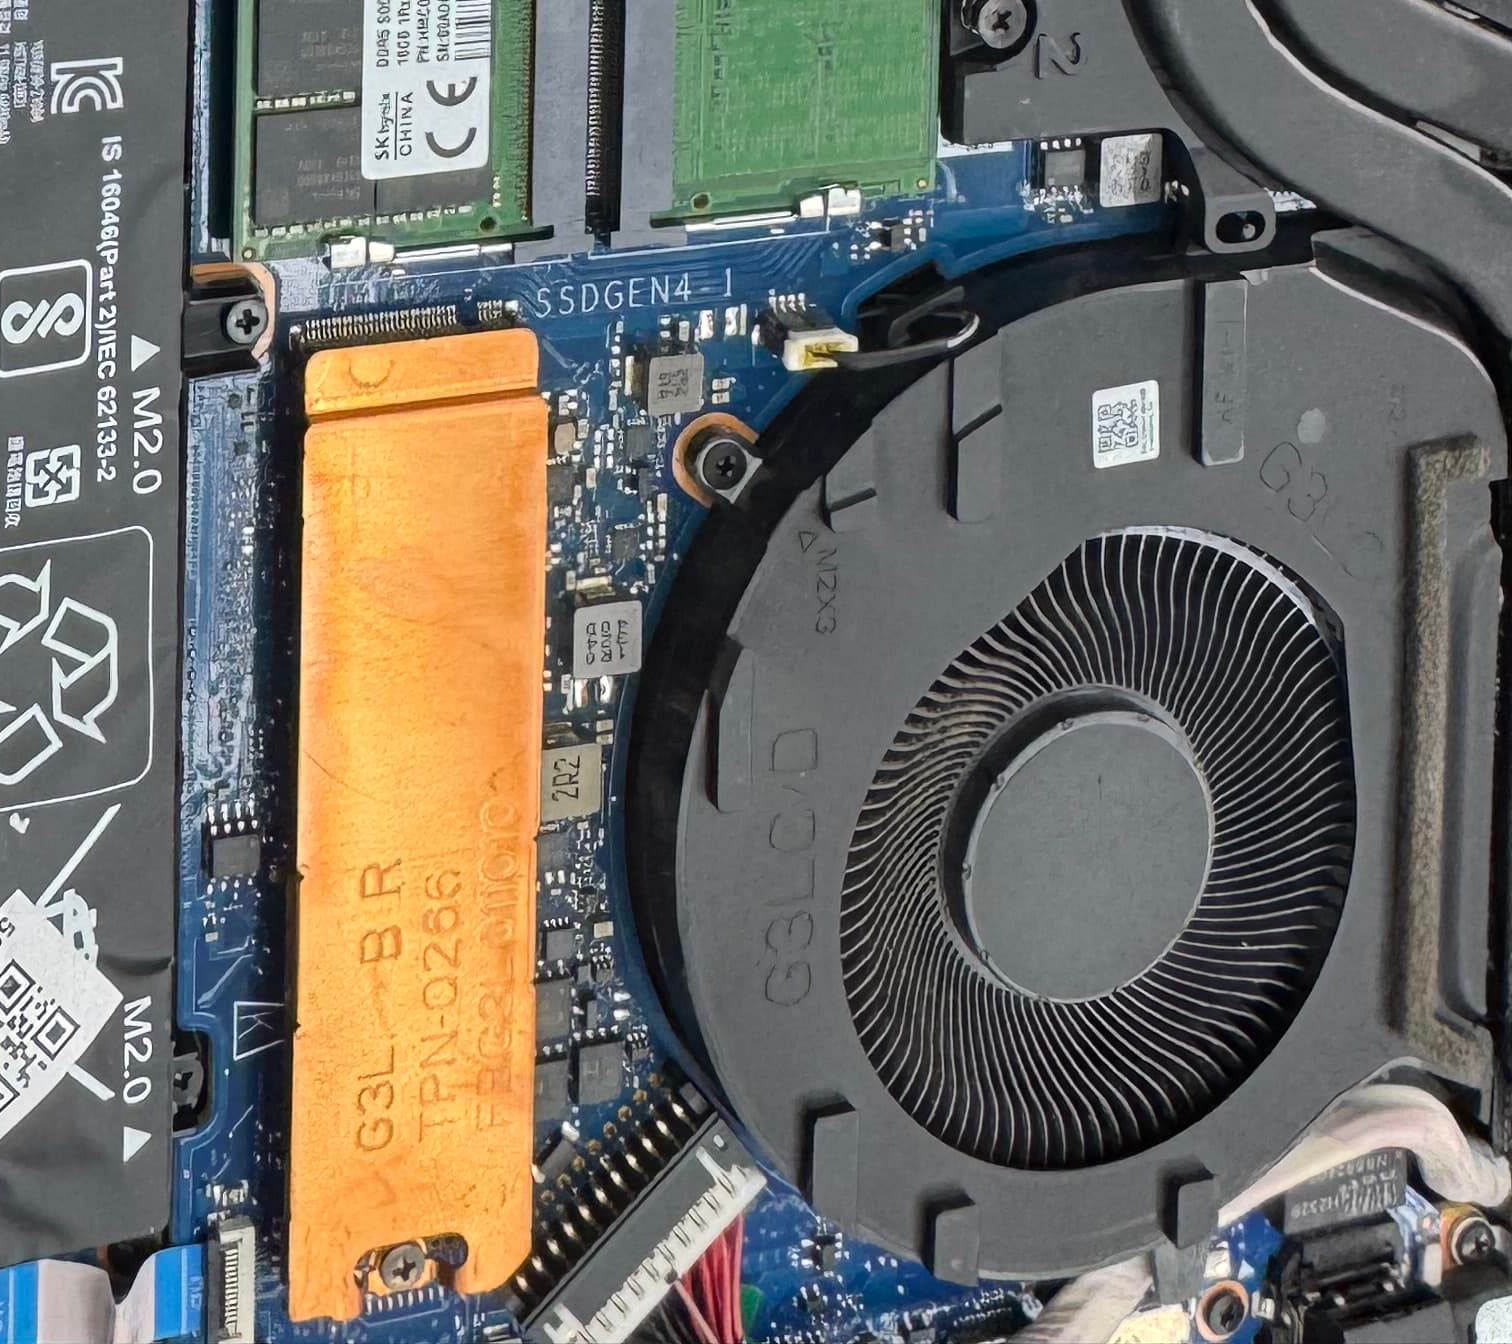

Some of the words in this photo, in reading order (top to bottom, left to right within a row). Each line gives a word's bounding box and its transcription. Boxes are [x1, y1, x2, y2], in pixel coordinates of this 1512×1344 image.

[1036, 34, 1087, 79] 2
[102, 136, 122, 162] IS
[399, 92, 412, 157] CHINA
[96, 169, 122, 302] 16046(Part
[97, 386, 117, 482] 62133-2
[132, 387, 163, 494] M2.0
[123, 996, 152, 1104] M2.0
